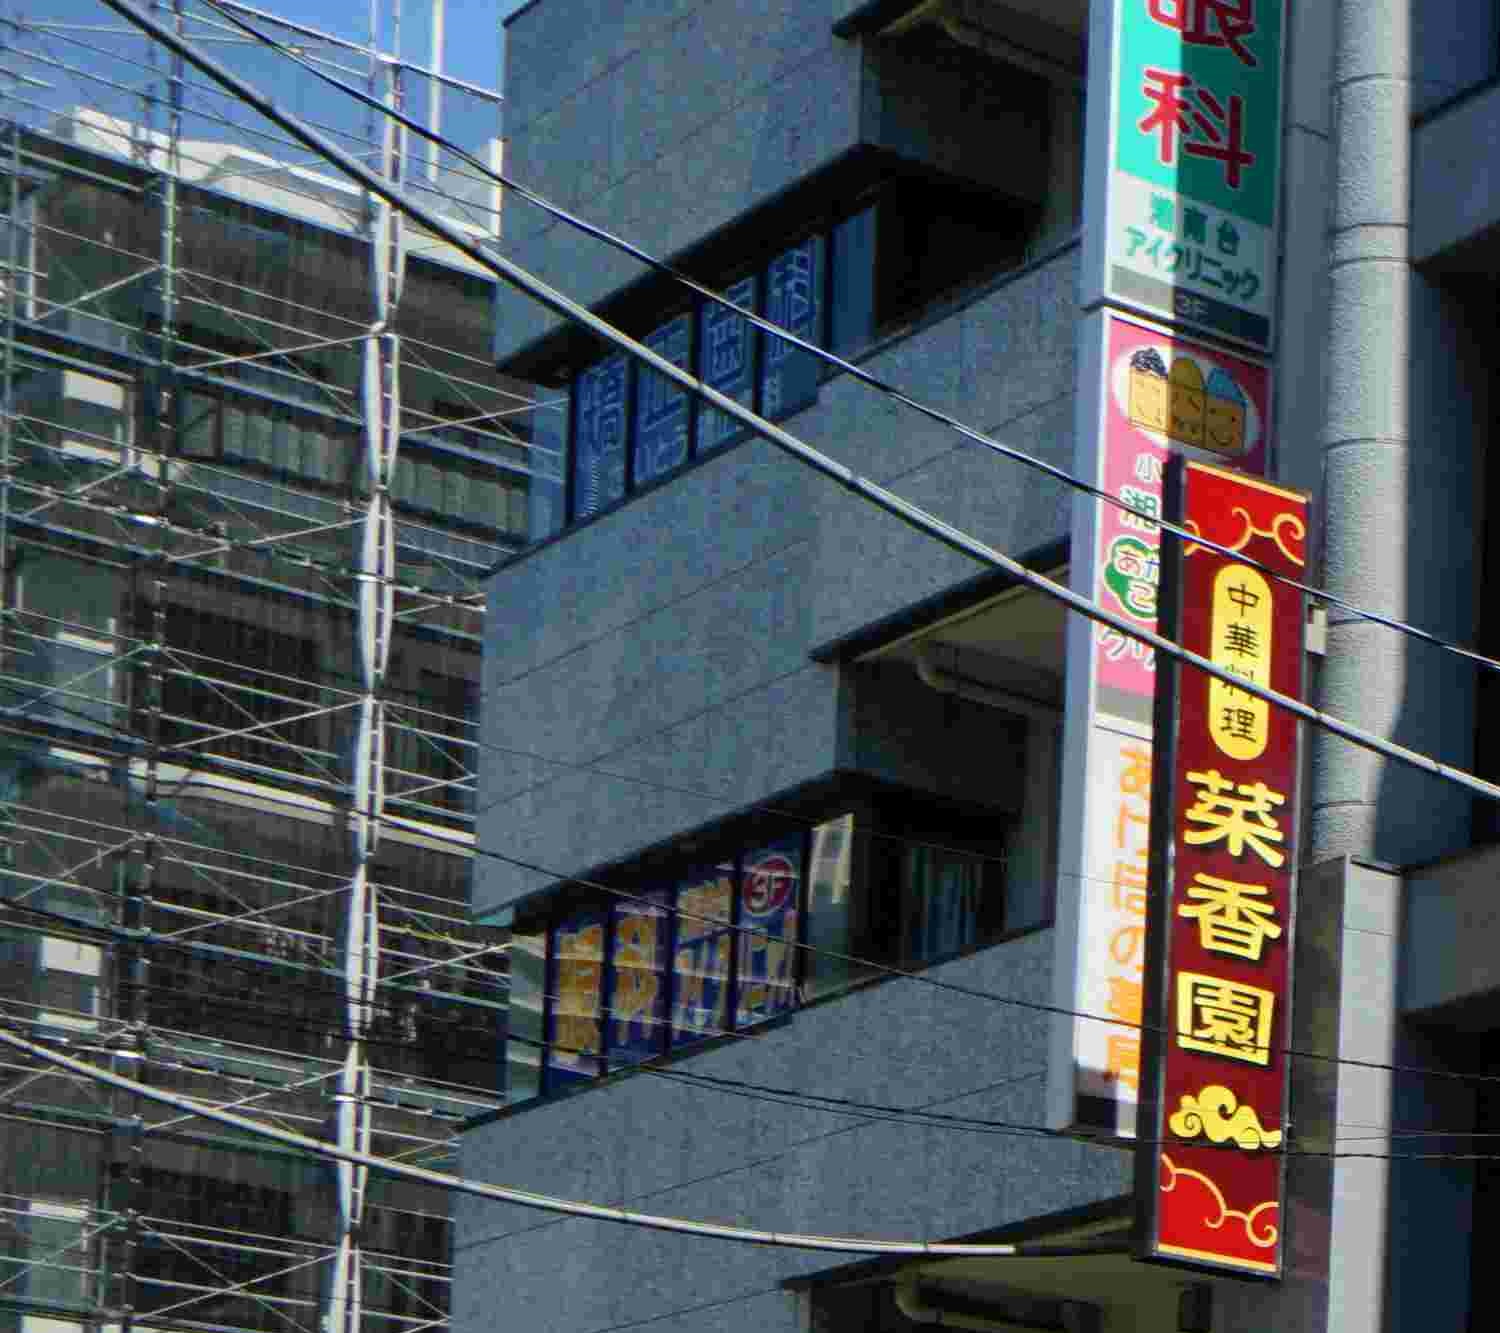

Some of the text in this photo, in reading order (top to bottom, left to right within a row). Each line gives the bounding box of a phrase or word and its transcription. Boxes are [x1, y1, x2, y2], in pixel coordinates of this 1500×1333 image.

[1125, 225, 1260, 298] アイクリニック
[1221, 582, 1259, 744] 中華料理
[1176, 768, 1288, 1068] 菜香園
